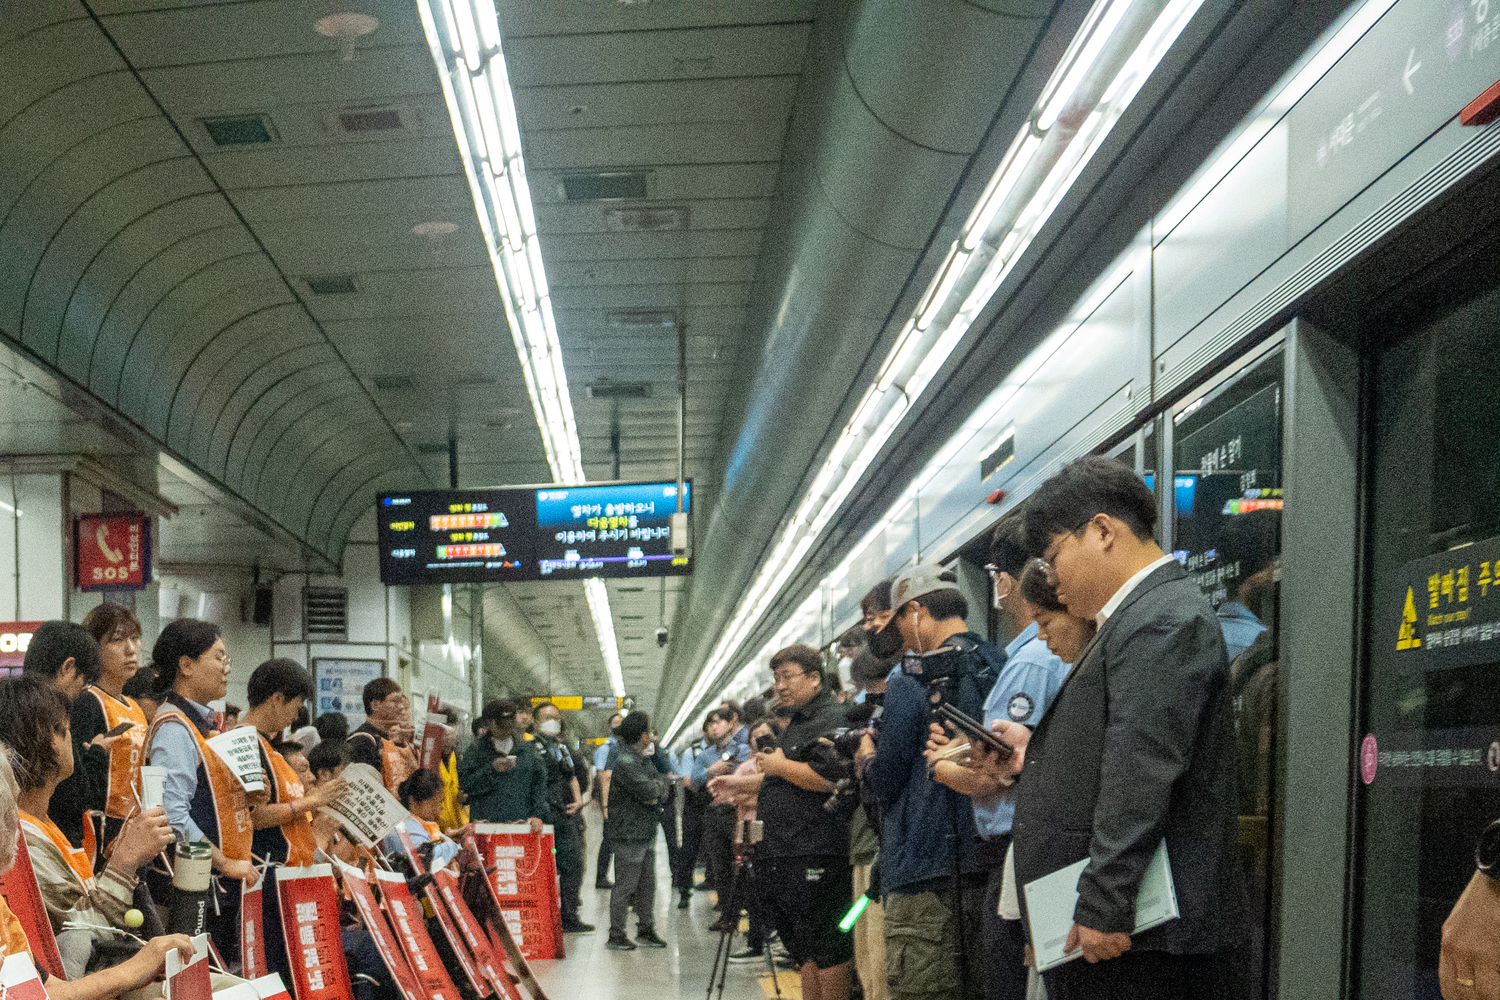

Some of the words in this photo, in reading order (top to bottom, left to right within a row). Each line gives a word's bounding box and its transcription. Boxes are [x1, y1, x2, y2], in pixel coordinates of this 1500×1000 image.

[570, 503, 603, 519] 열차가
[605, 501, 655, 517] 출발하오니
[587, 515, 639, 530] 다음열차를
[555, 530, 597, 544] 이용하여
[598, 528, 629, 542] 주시기
[92, 566, 129, 580] SOS
[1427, 563, 1471, 609] 발빠짐
